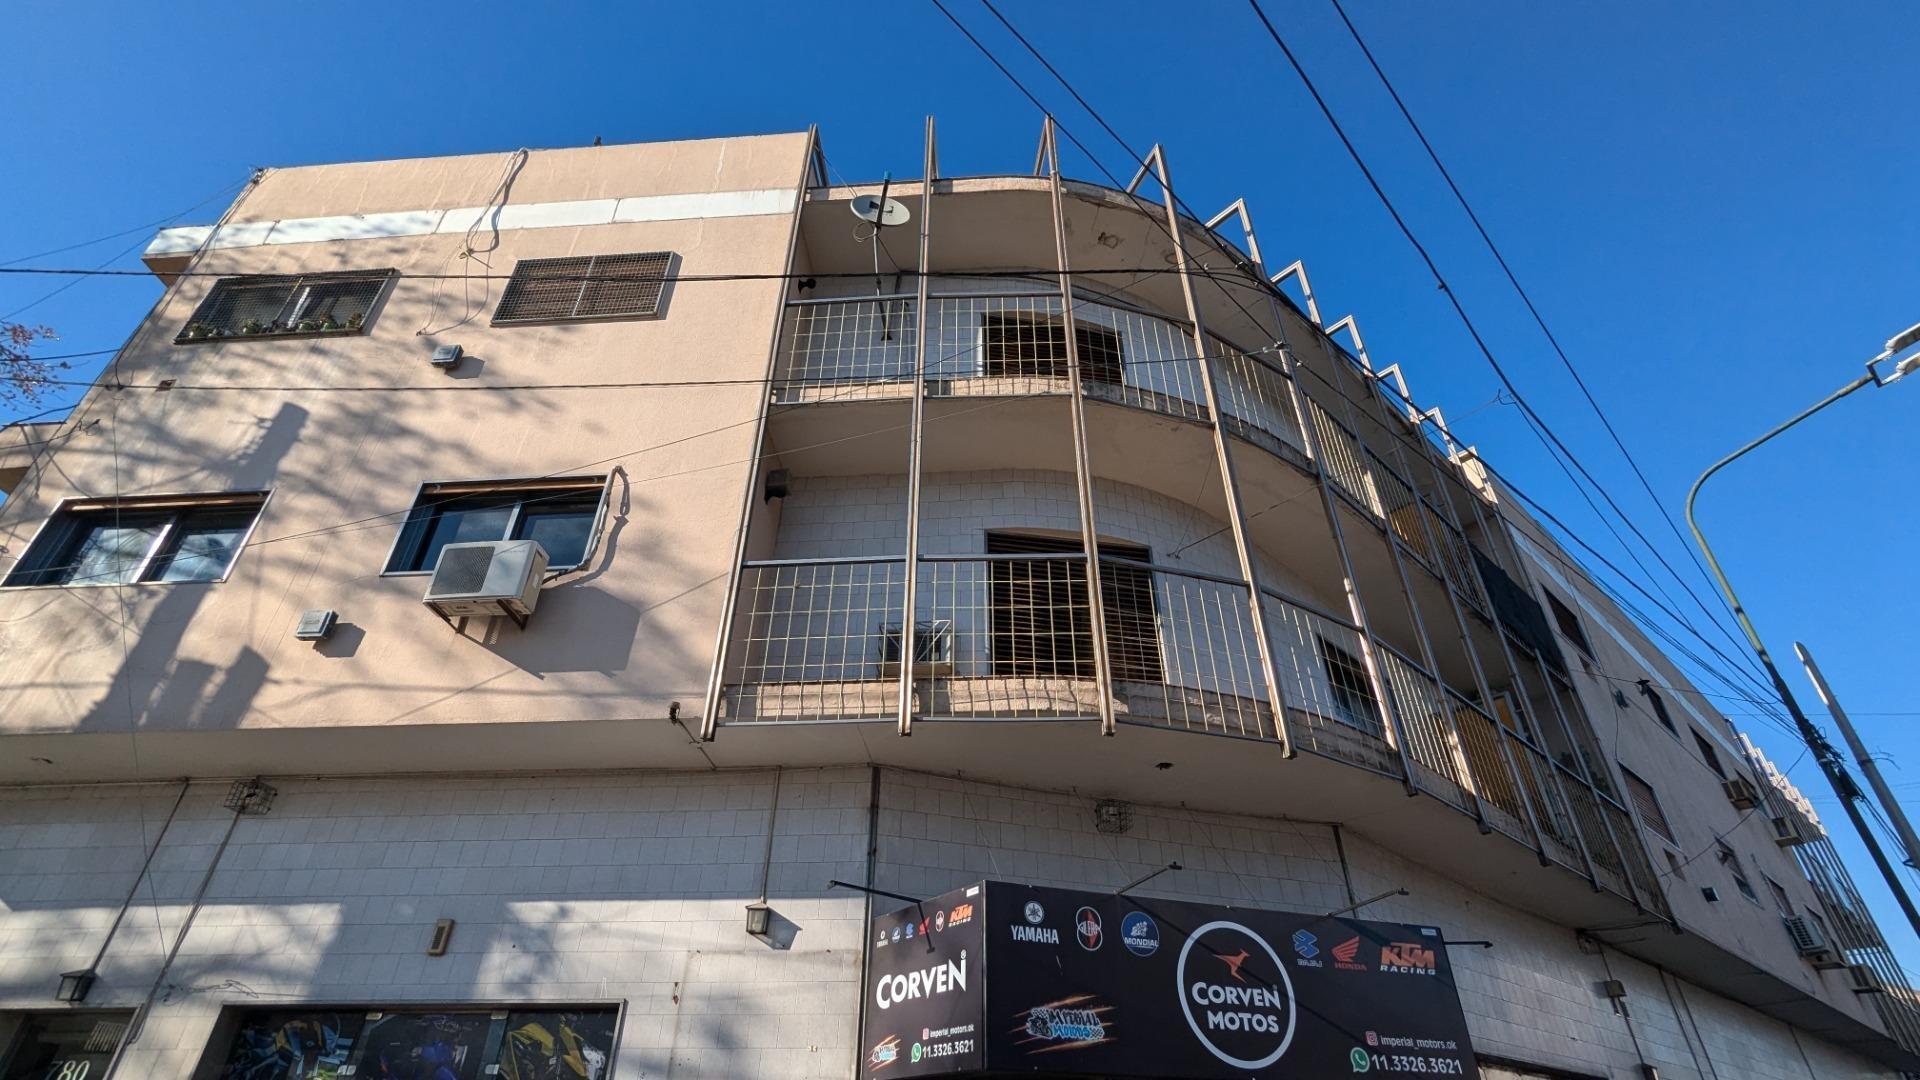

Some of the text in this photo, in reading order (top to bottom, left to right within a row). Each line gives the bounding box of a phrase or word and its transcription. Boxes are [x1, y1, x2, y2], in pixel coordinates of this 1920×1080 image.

[1011, 925, 1059, 944] YAMAHA
[1124, 937, 1159, 947] MONDIAL
[1381, 942, 1435, 968] KTM
[1335, 961, 1367, 971] HONDA
[1380, 965, 1436, 975] RACING
[876, 957, 966, 1009] CORVEN
[1192, 982, 1281, 1010] CORVEN
[1207, 1010, 1279, 1033] MOTOS
[922, 1039, 974, 1058] 11.3326.3621
[45, 1060, 90, 1080] 780
[1371, 1054, 1463, 1074] 11.3326.3621
